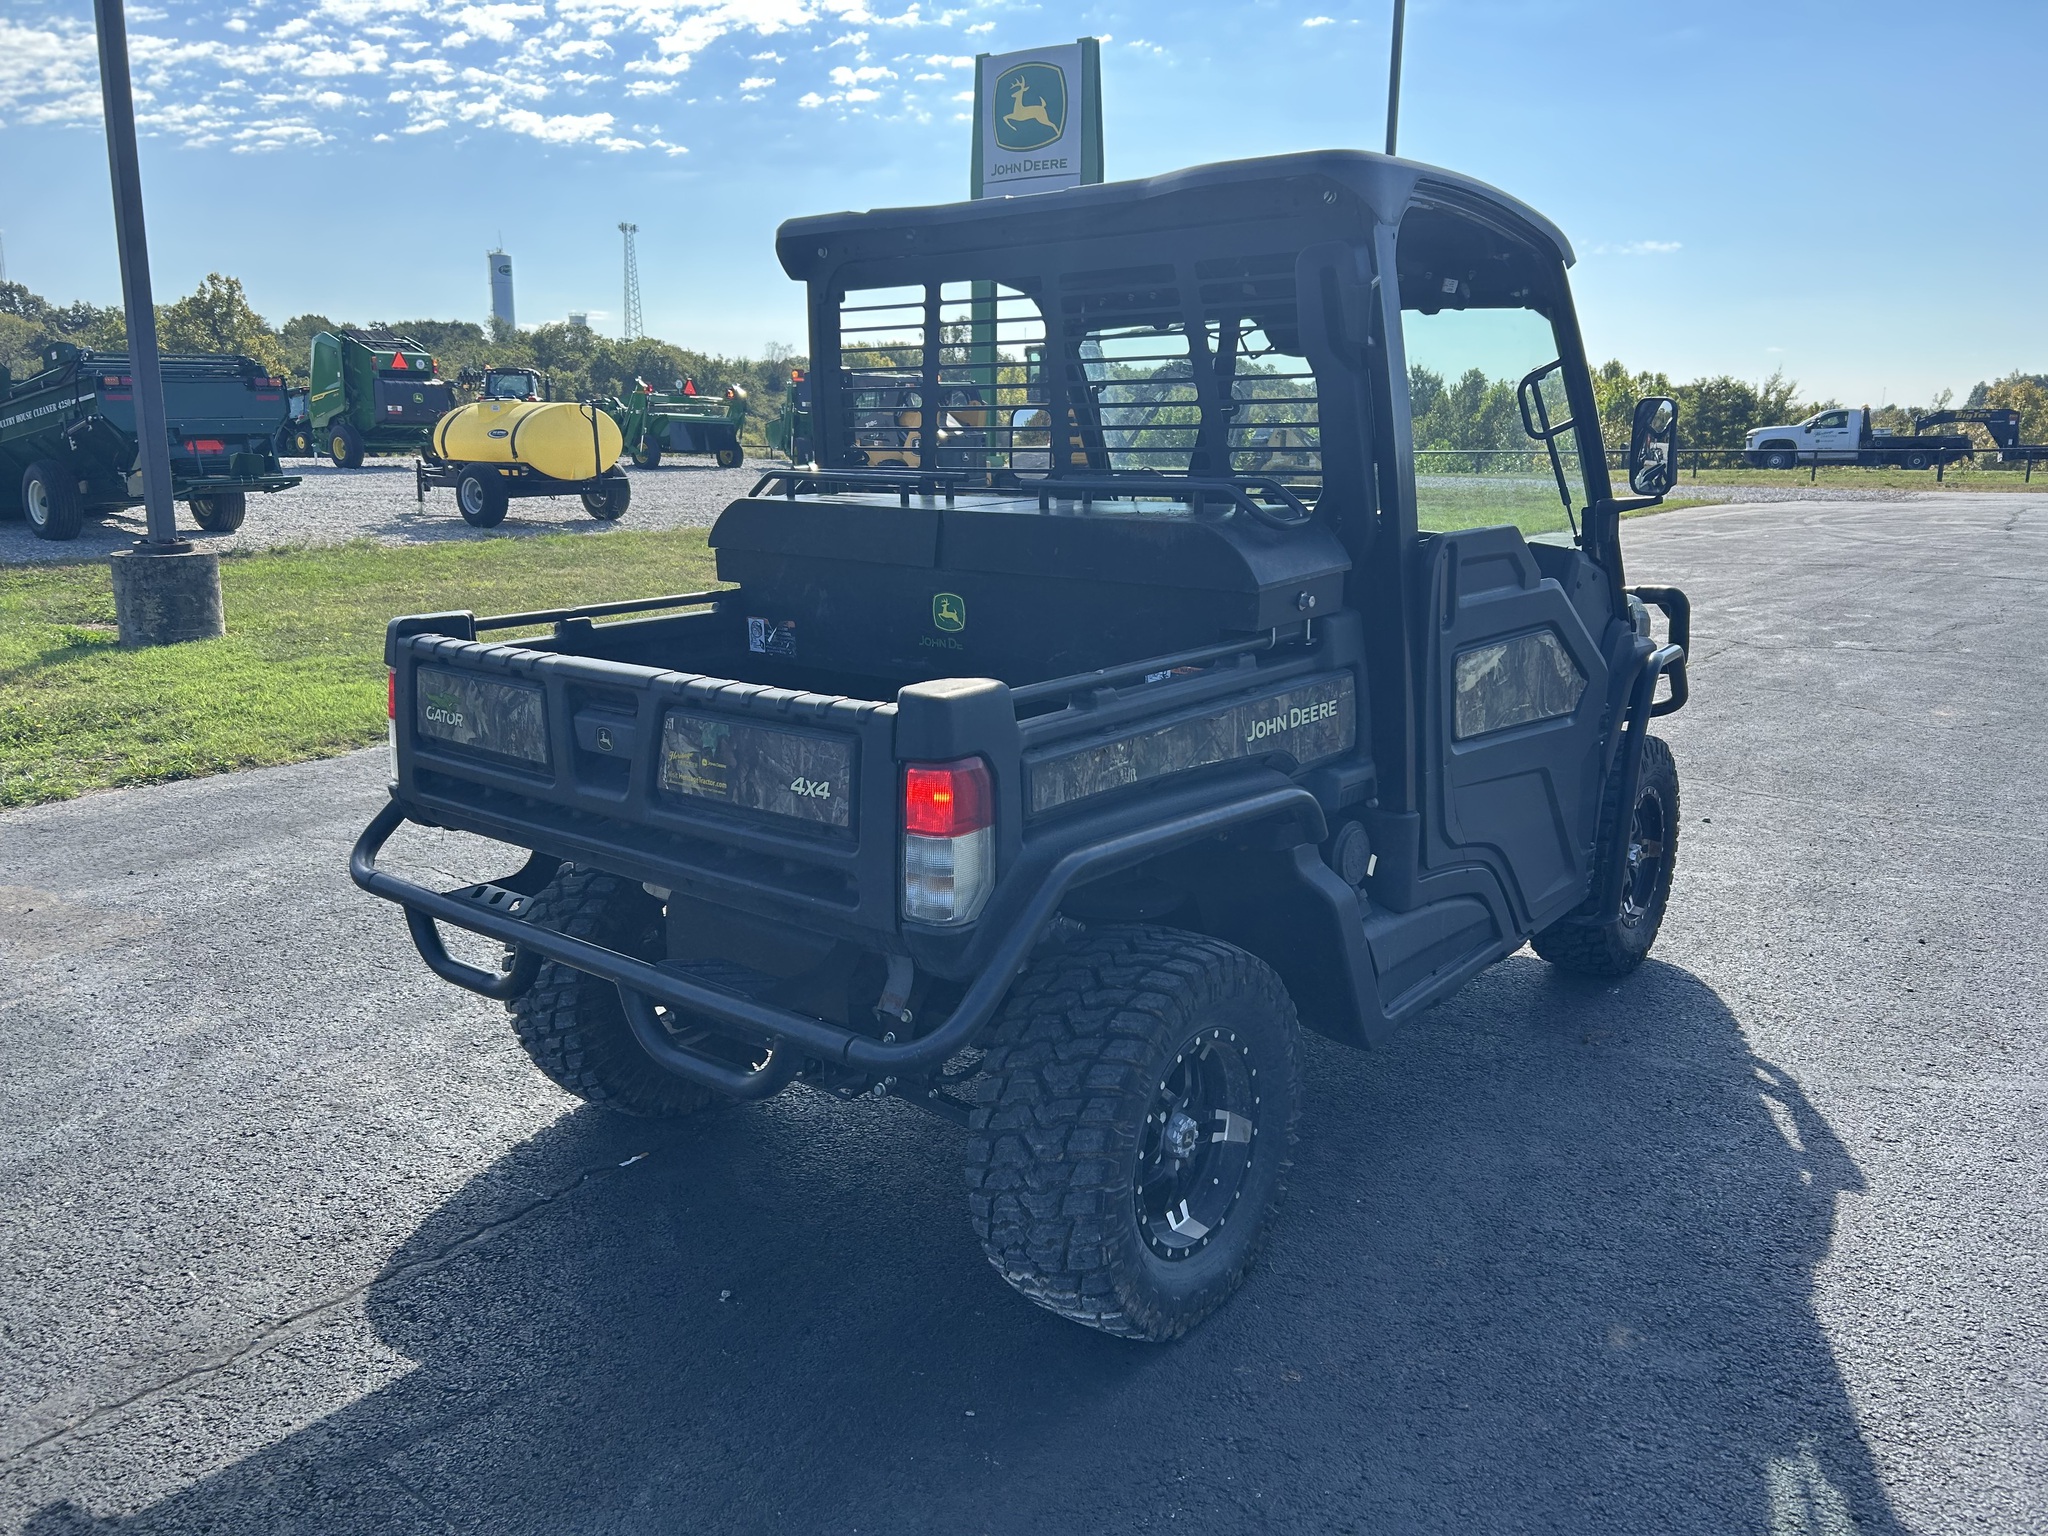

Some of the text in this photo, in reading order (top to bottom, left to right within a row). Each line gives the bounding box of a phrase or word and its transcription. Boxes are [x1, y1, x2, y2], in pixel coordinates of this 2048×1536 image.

[991, 158, 1068, 176] JOHN DEERE
[33, 403, 58, 418] CLEANER
[919, 635, 947, 649] JOHN
[426, 705, 464, 728] GATOR
[1247, 700, 1338, 742] JOHN DEERE
